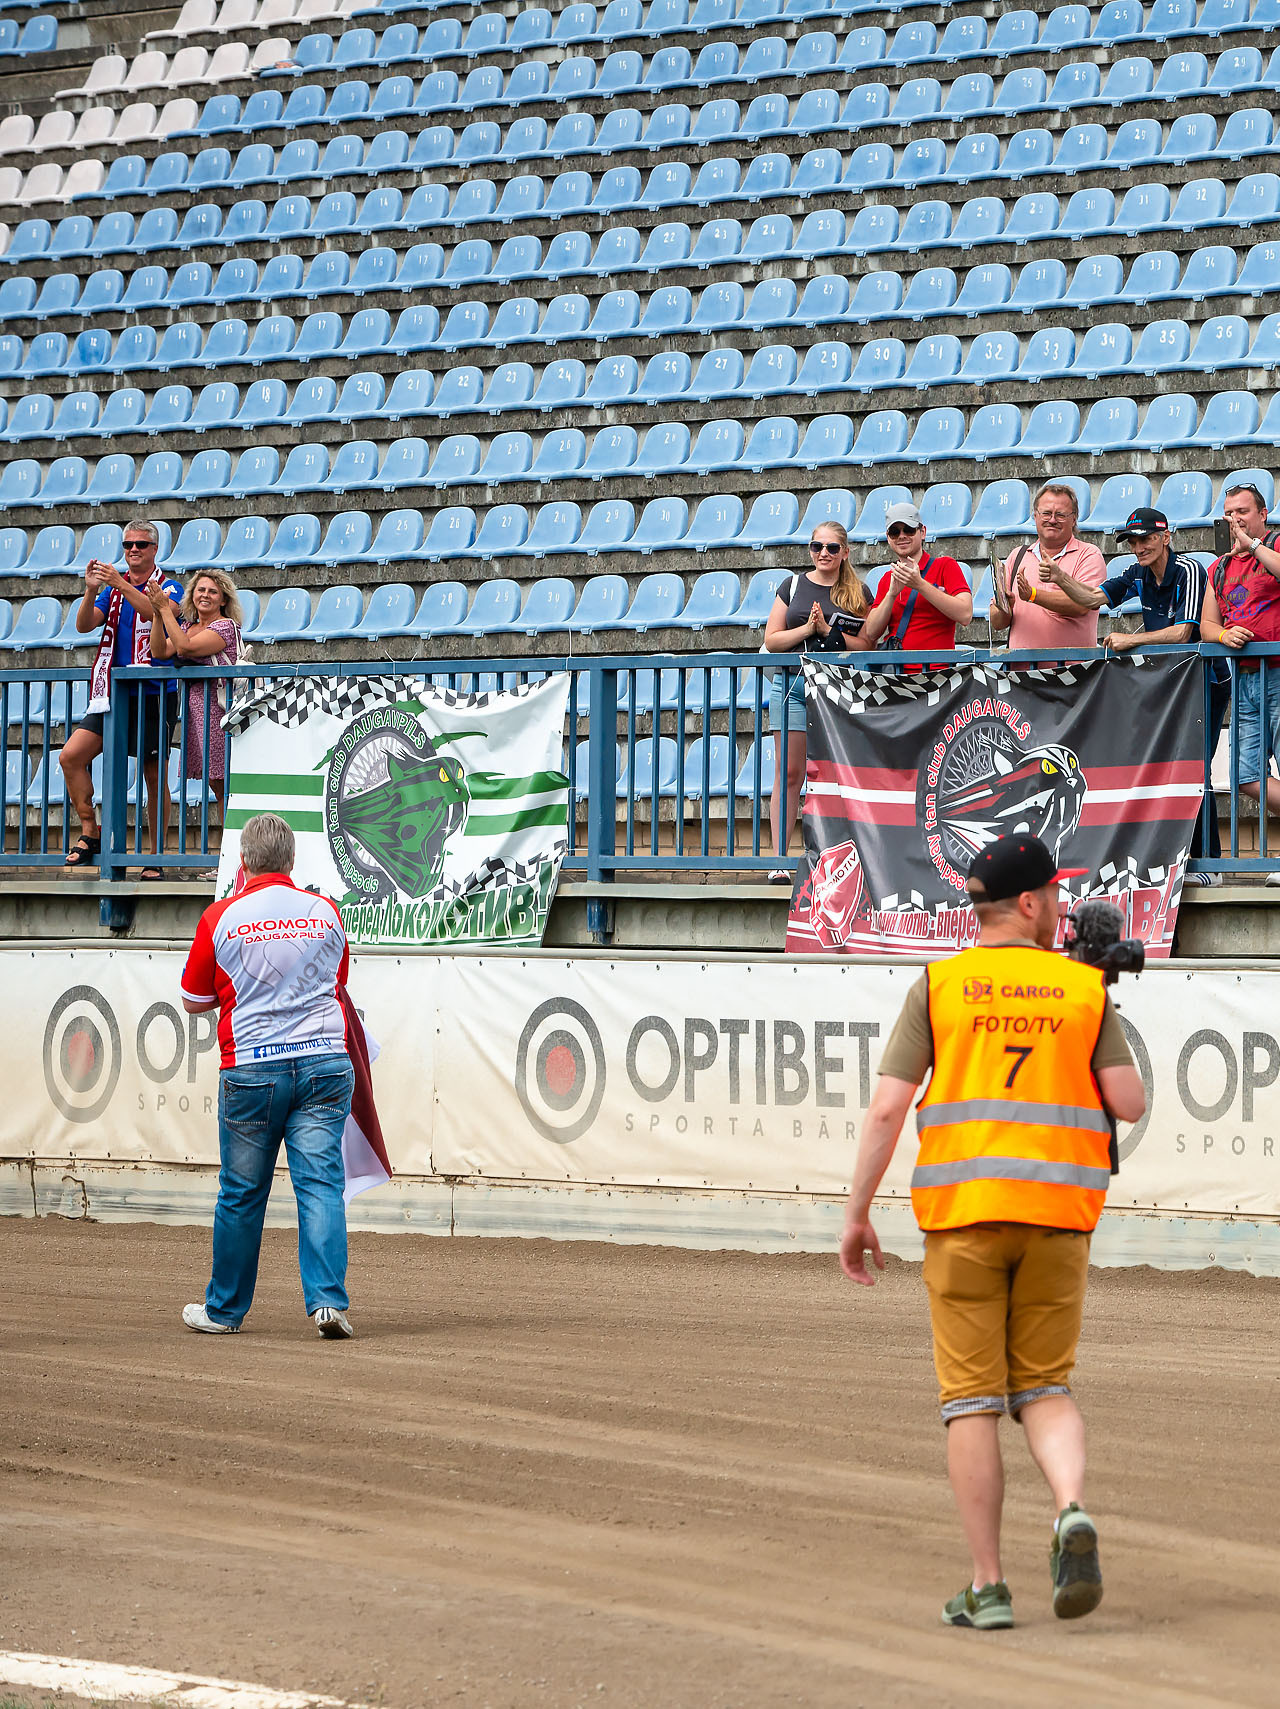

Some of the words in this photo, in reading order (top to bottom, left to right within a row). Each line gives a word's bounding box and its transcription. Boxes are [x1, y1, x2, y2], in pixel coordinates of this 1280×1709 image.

[1100, 332, 1116, 348] 34
[1159, 329, 1176, 345] 35
[1215, 325, 1233, 340] 36
[873, 347, 890, 361] 30
[929, 343, 943, 360] 31
[984, 341, 1003, 361] 32
[1043, 339, 1059, 361] 33
[663, 359, 677, 374] 26
[714, 357, 728, 370] 27
[767, 353, 783, 370] 28
[820, 350, 838, 369] 29
[505, 370, 517, 384] 23
[557, 367, 571, 382] 24
[612, 363, 625, 379] 25
[356, 380, 371, 396] 20
[407, 377, 420, 391] 21
[457, 375, 469, 387] 22
[261, 385, 271, 403] 18
[311, 385, 323, 401] 19
[943, 697, 1032, 744] DAUGAVPILS
[342, 709, 426, 751] DAUGAVPILS
[330, 751, 346, 791] club
[927, 740, 947, 787] club
[329, 798, 340, 833] fan
[925, 793, 938, 831] fan
[333, 835, 379, 894] speedway
[927, 833, 968, 894] eedway
[226, 918, 334, 940] LOKOMOTIV
[245, 932, 325, 945] DAUGAVPILS
[1000, 985, 1065, 999] CARGO
[972, 1015, 1064, 1034] FOTO/TV
[625, 1015, 880, 1109] OPTIBET
[1003, 1043, 1034, 1090] 7
[138, 1094, 212, 1114] SPOR
[625, 1112, 765, 1138] SPORTA
[792, 1115, 856, 1140] BĀR
